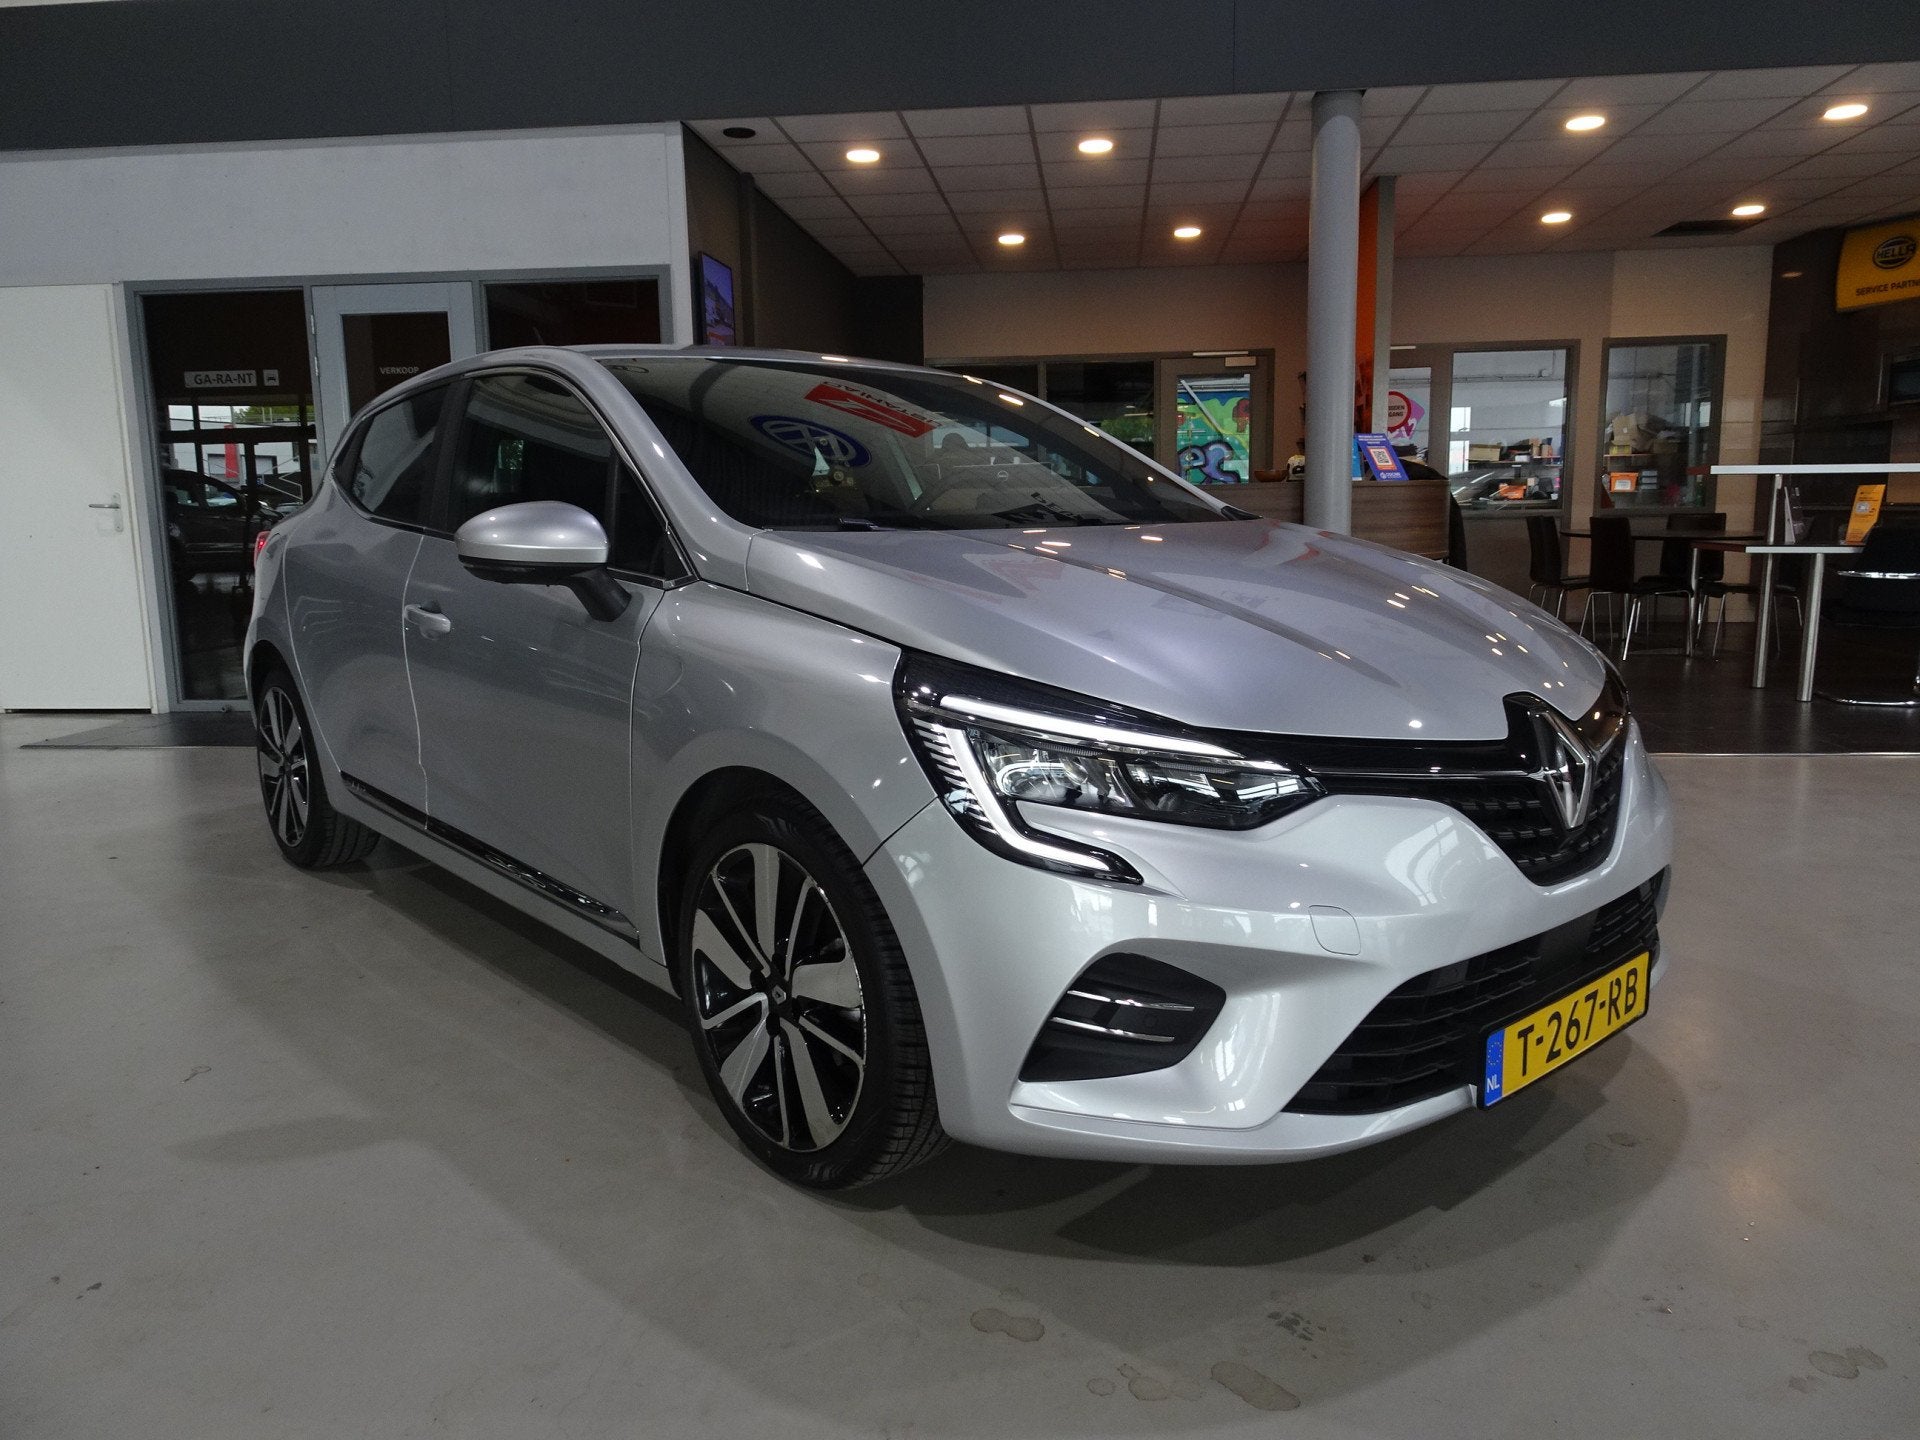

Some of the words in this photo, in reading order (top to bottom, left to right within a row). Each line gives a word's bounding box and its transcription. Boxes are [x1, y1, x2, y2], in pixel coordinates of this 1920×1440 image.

[1855, 284, 1889, 296] SERVICE
[378, 366, 420, 375] VERKOOP
[194, 373, 253, 385] GA-RA-NT
[1517, 967, 1638, 1077] T-267-RB
[1487, 1074, 1500, 1093] NL
